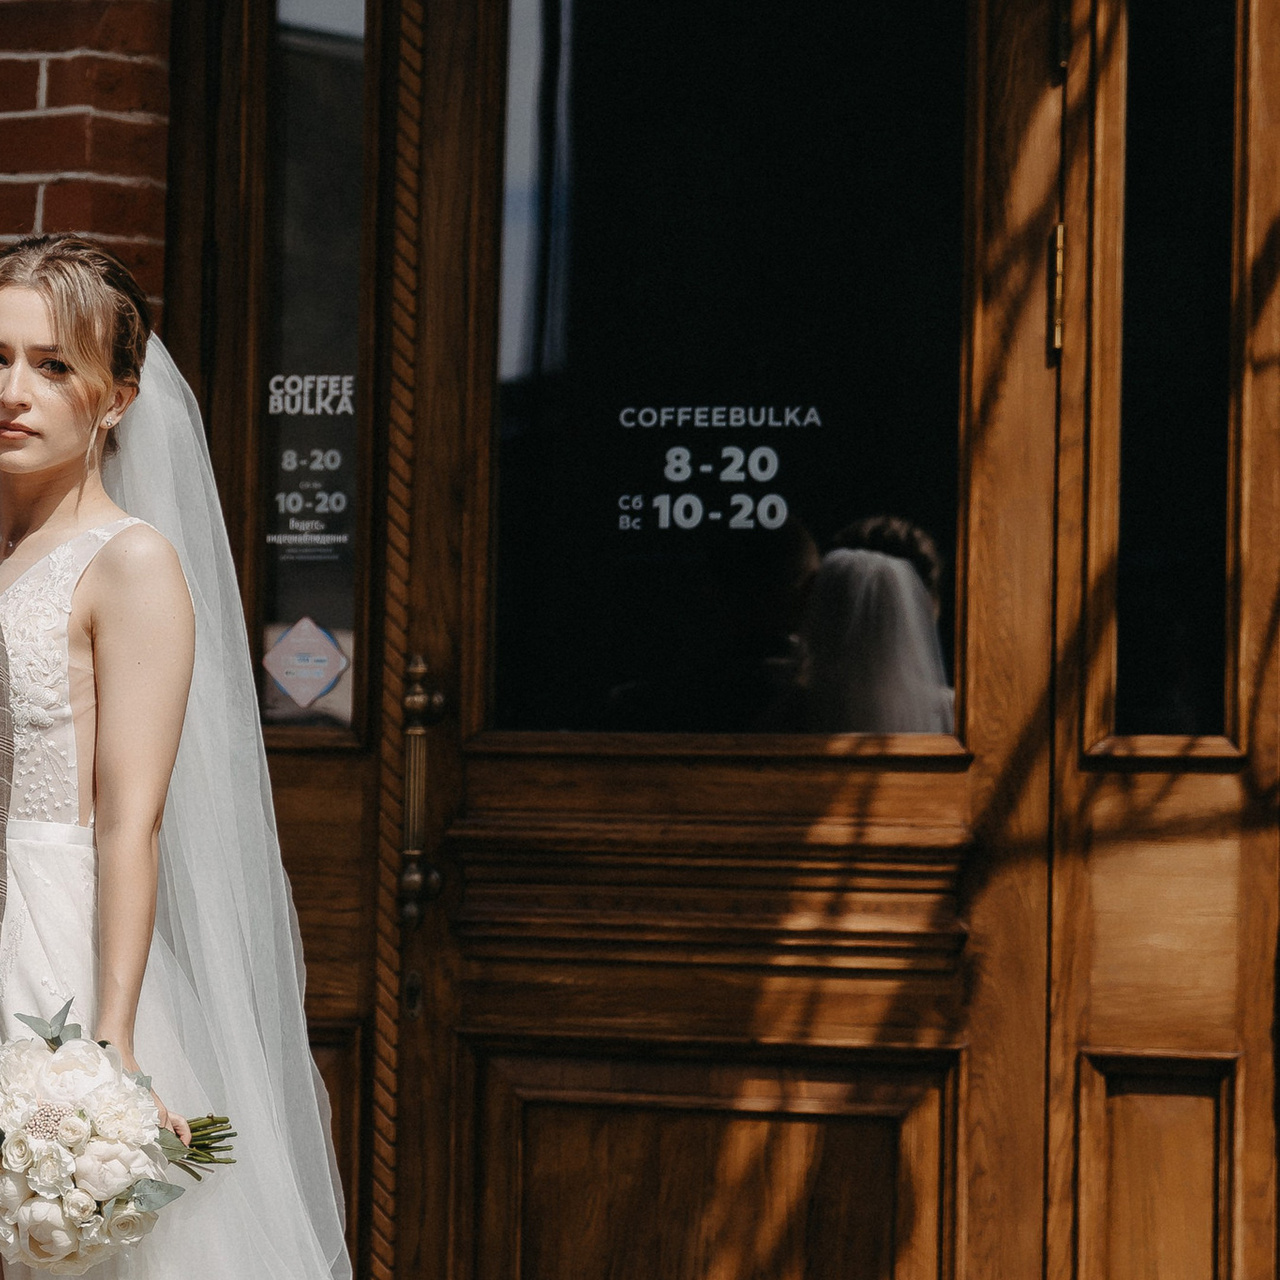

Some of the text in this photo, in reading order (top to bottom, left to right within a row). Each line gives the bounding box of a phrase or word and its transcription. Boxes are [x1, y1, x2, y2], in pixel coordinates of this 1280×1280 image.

[269, 375, 354, 396] COFFEE
[269, 394, 355, 415] BULKA
[619, 406, 822, 428] COFFEEBULKA
